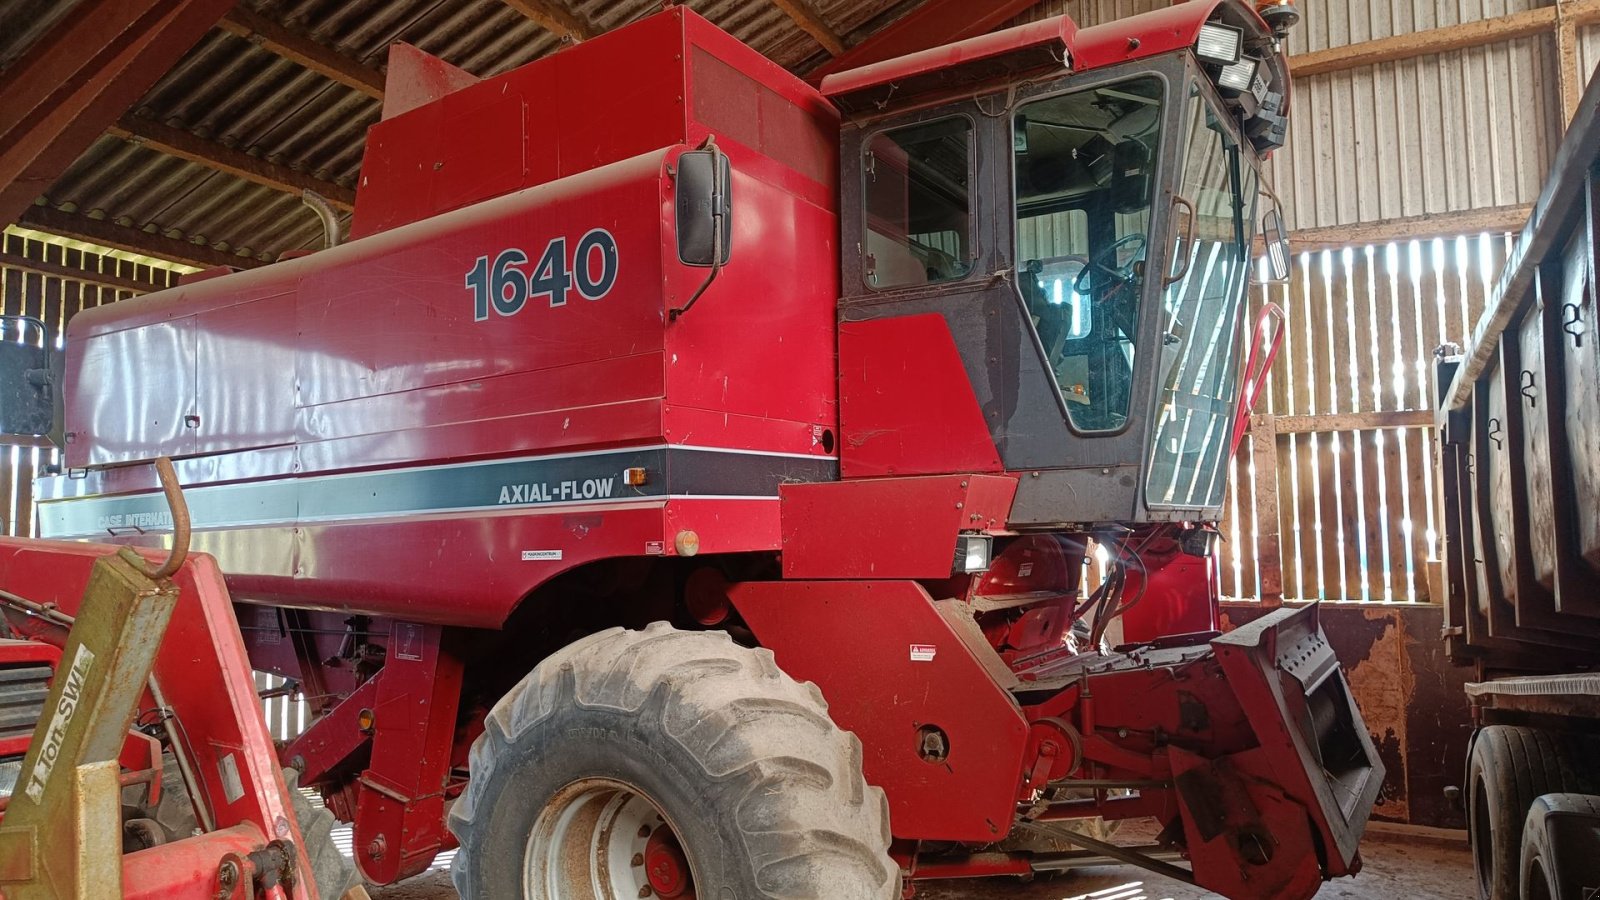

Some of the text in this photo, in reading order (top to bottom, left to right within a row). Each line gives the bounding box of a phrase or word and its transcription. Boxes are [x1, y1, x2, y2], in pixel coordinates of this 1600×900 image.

[465, 227, 619, 322] 1640
[498, 478, 614, 504] AXIAL-FLOW
[98, 514, 122, 529] CASE
[38, 728, 64, 771] Ton
[33, 774, 44, 789] 1
